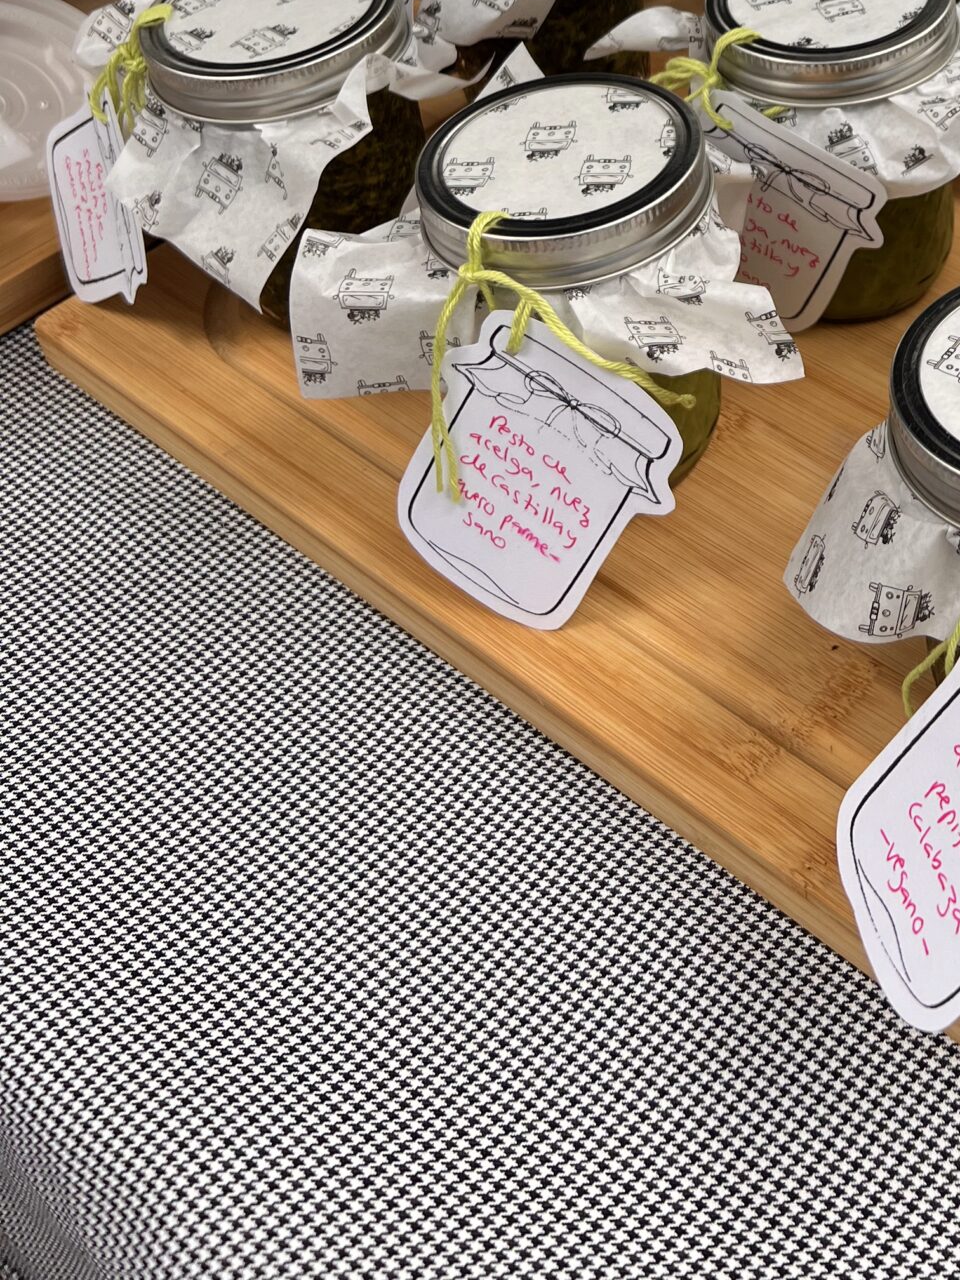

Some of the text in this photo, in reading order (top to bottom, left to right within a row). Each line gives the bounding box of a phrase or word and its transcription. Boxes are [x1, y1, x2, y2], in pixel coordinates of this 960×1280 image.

[777, 213, 798, 232] de
[781, 238, 820, 268] nuez
[460, 454, 487, 480] de
[543, 454, 571, 484] de
[550, 486, 590, 528] nuez
